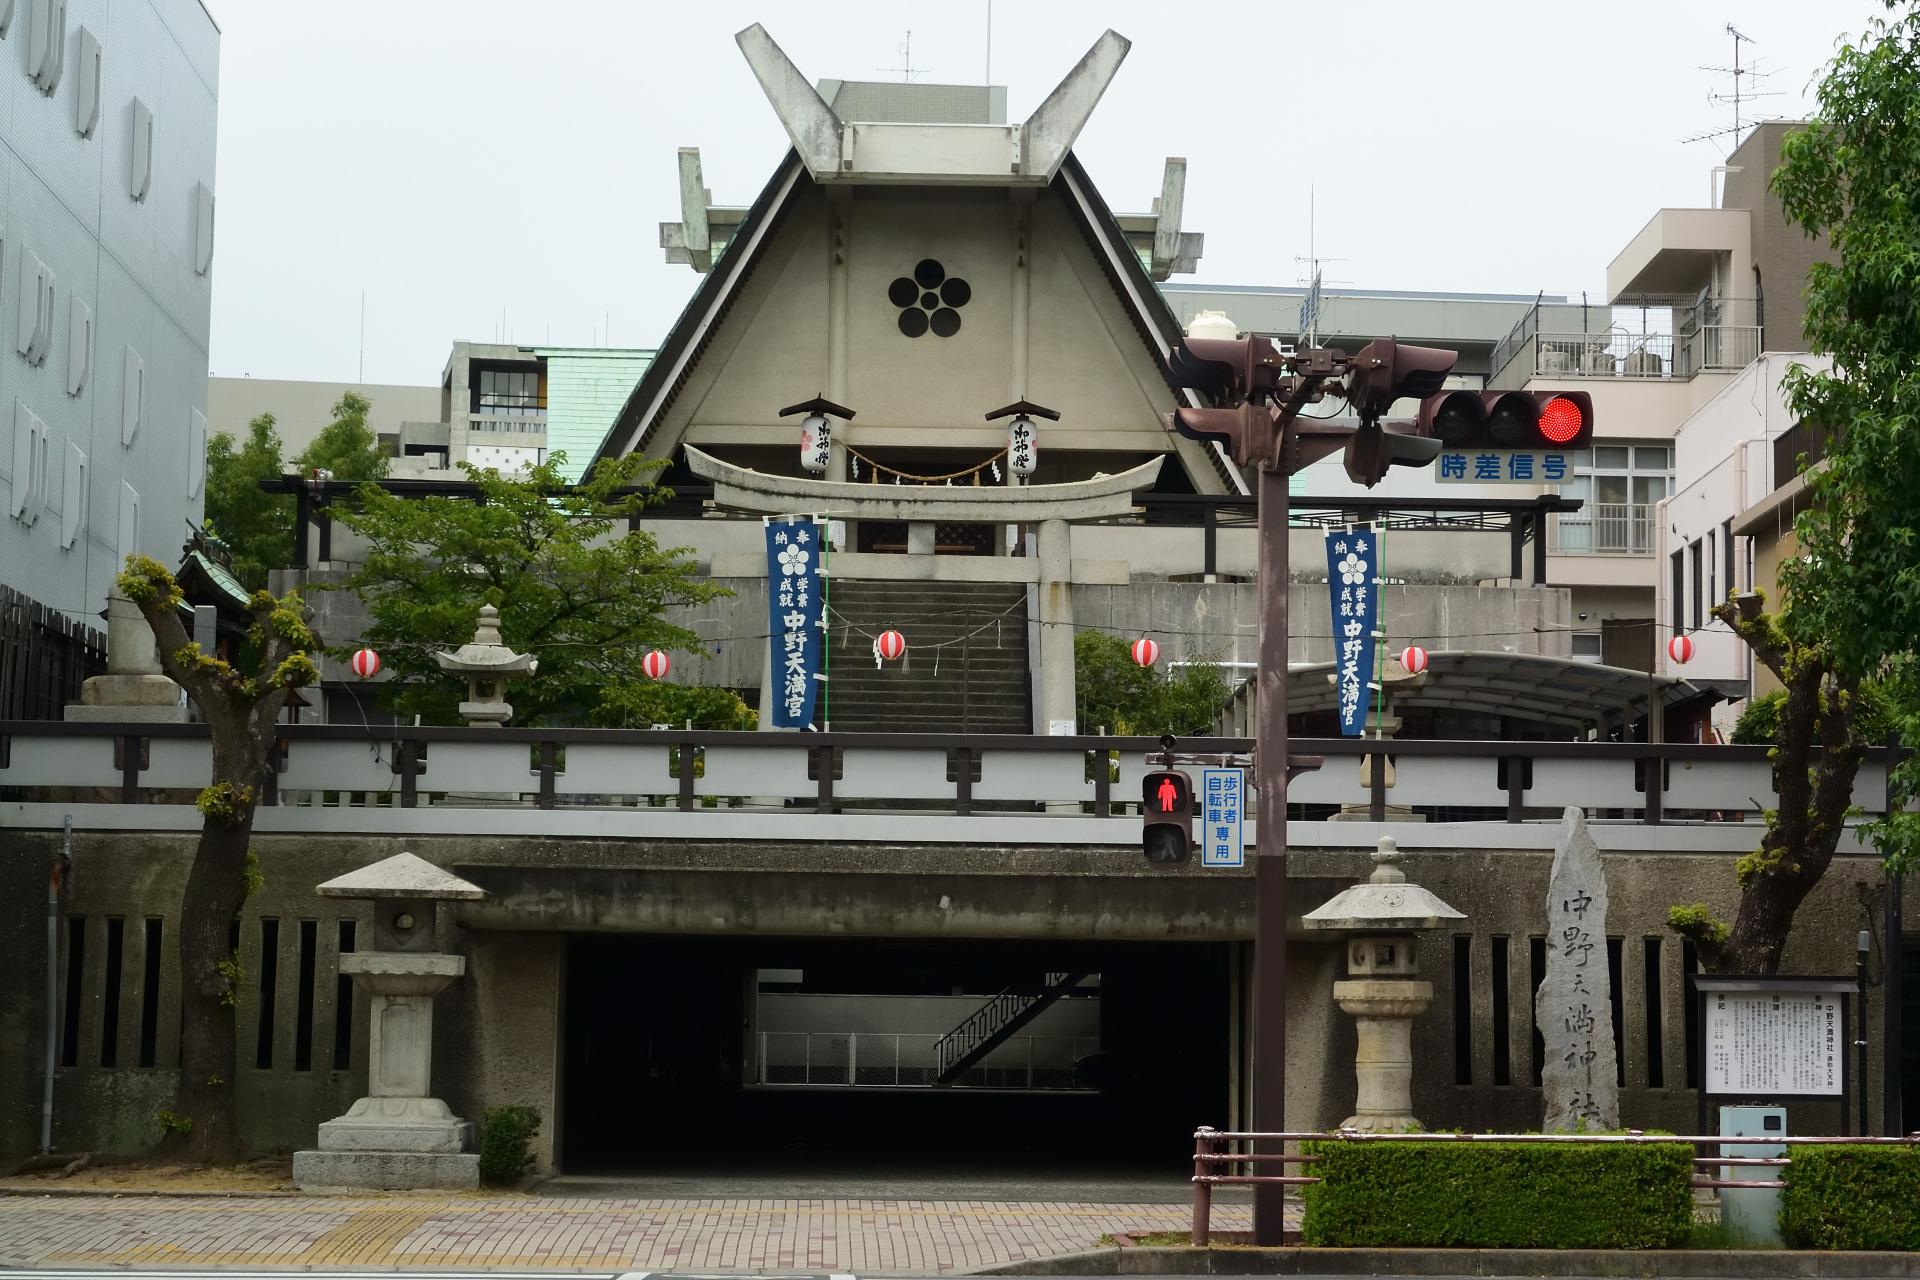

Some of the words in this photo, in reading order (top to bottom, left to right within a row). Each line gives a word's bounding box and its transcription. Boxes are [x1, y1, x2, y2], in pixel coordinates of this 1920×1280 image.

[1441, 453, 1567, 480] 時差信号
[783, 609, 807, 718] 中野天満宮
[1342, 619, 1362, 725] 中野天満宮
[1563, 889, 1600, 1119] 中野天満神社
